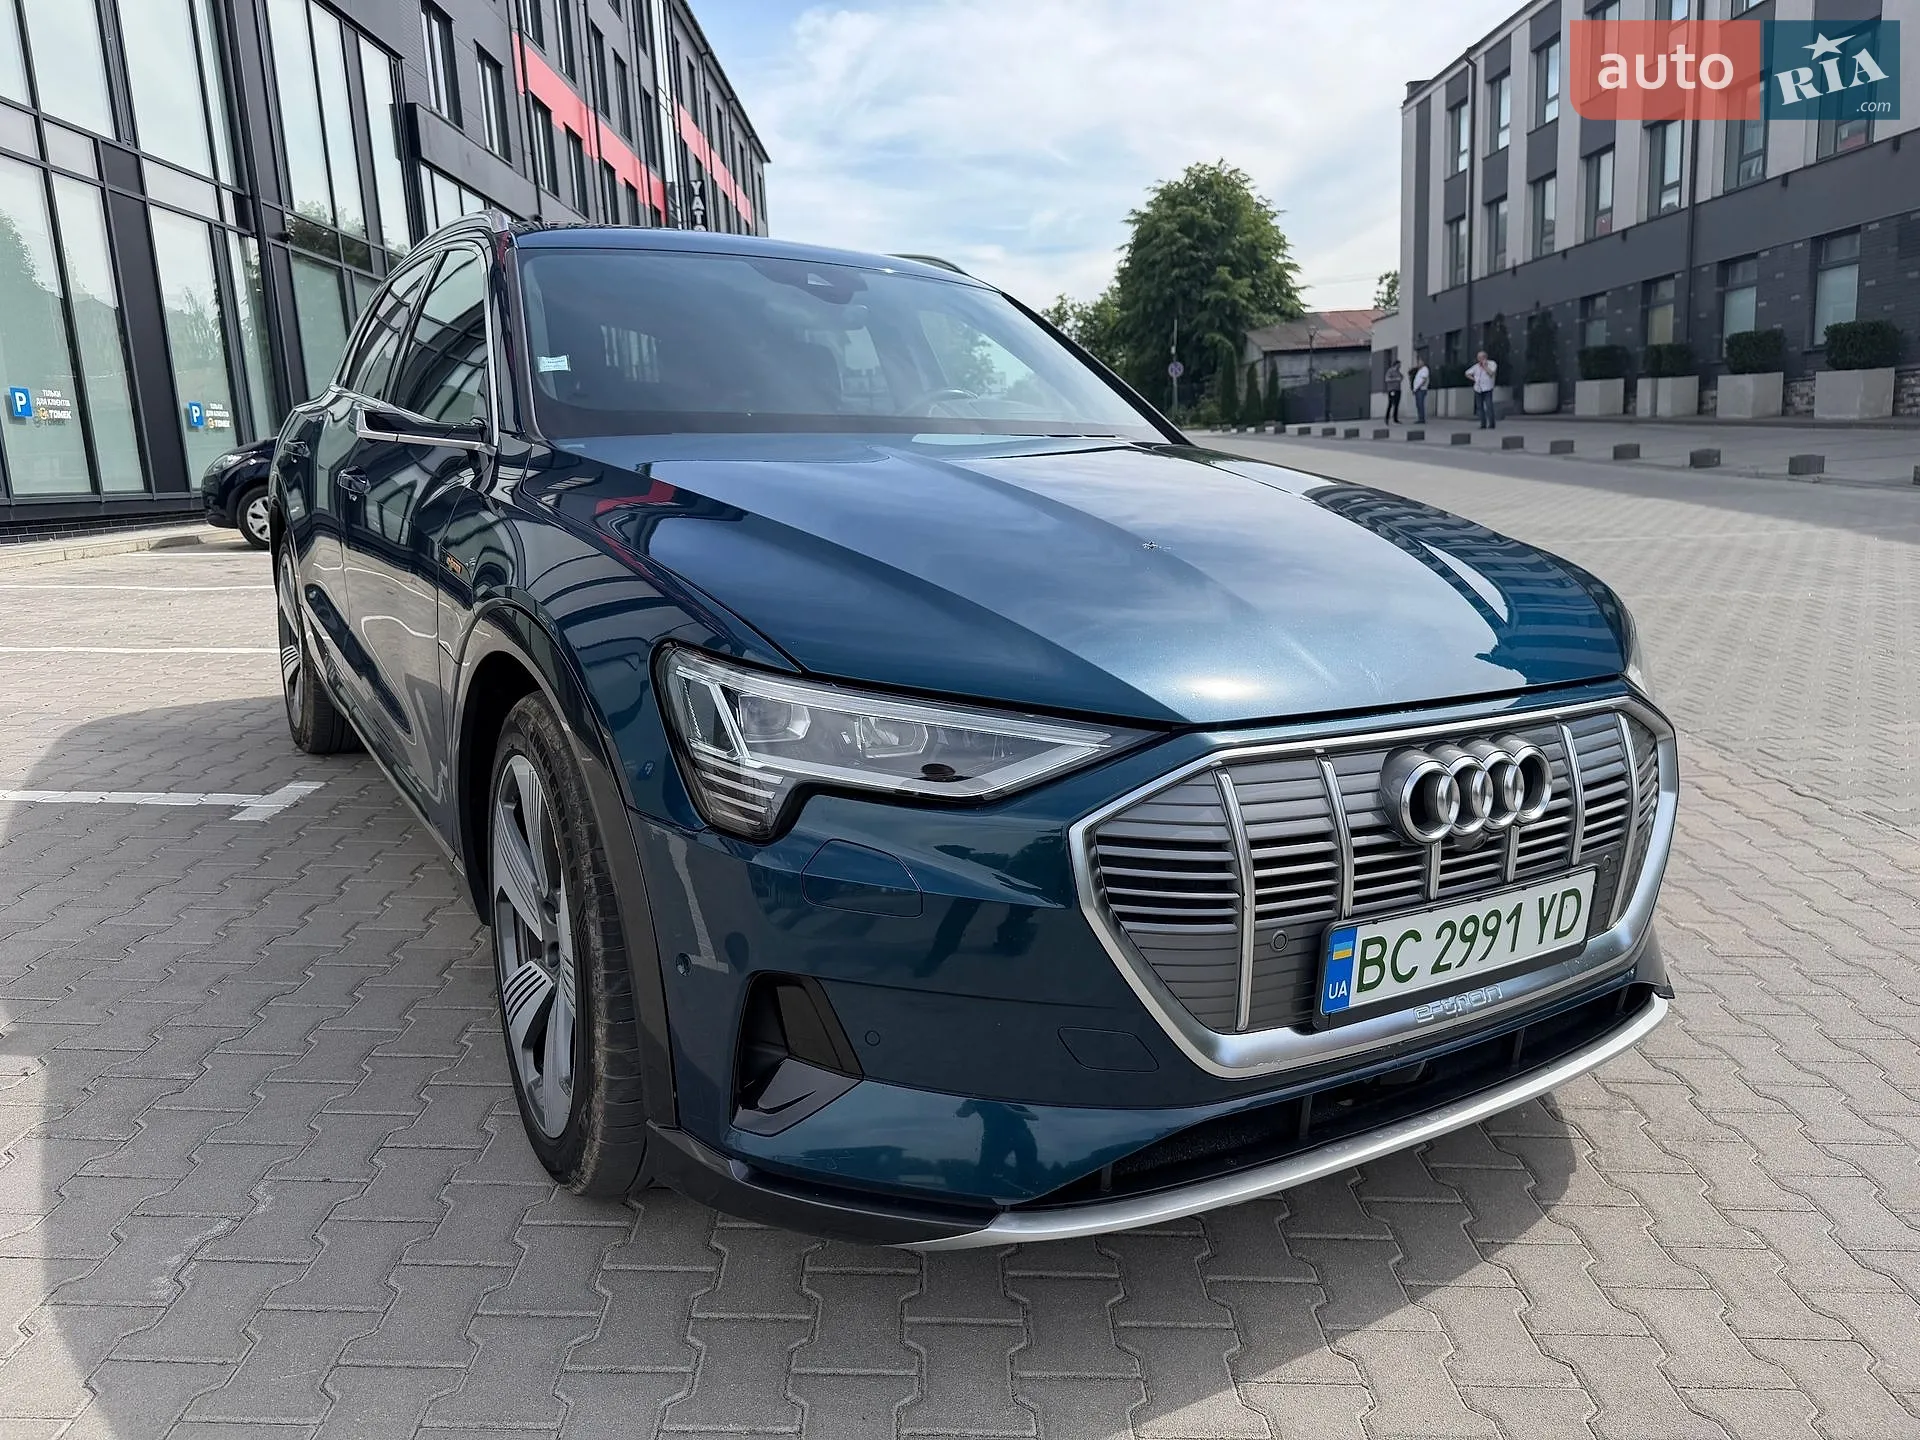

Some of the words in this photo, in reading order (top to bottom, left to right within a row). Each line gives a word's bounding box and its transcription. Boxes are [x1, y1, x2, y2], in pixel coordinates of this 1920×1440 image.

[14, 391, 27, 412] P
[191, 405, 201, 423] P
[1356, 929, 1422, 993] BC
[1430, 902, 1523, 975] 2991
[1538, 887, 1582, 945] YD
[1328, 980, 1348, 999] UA
